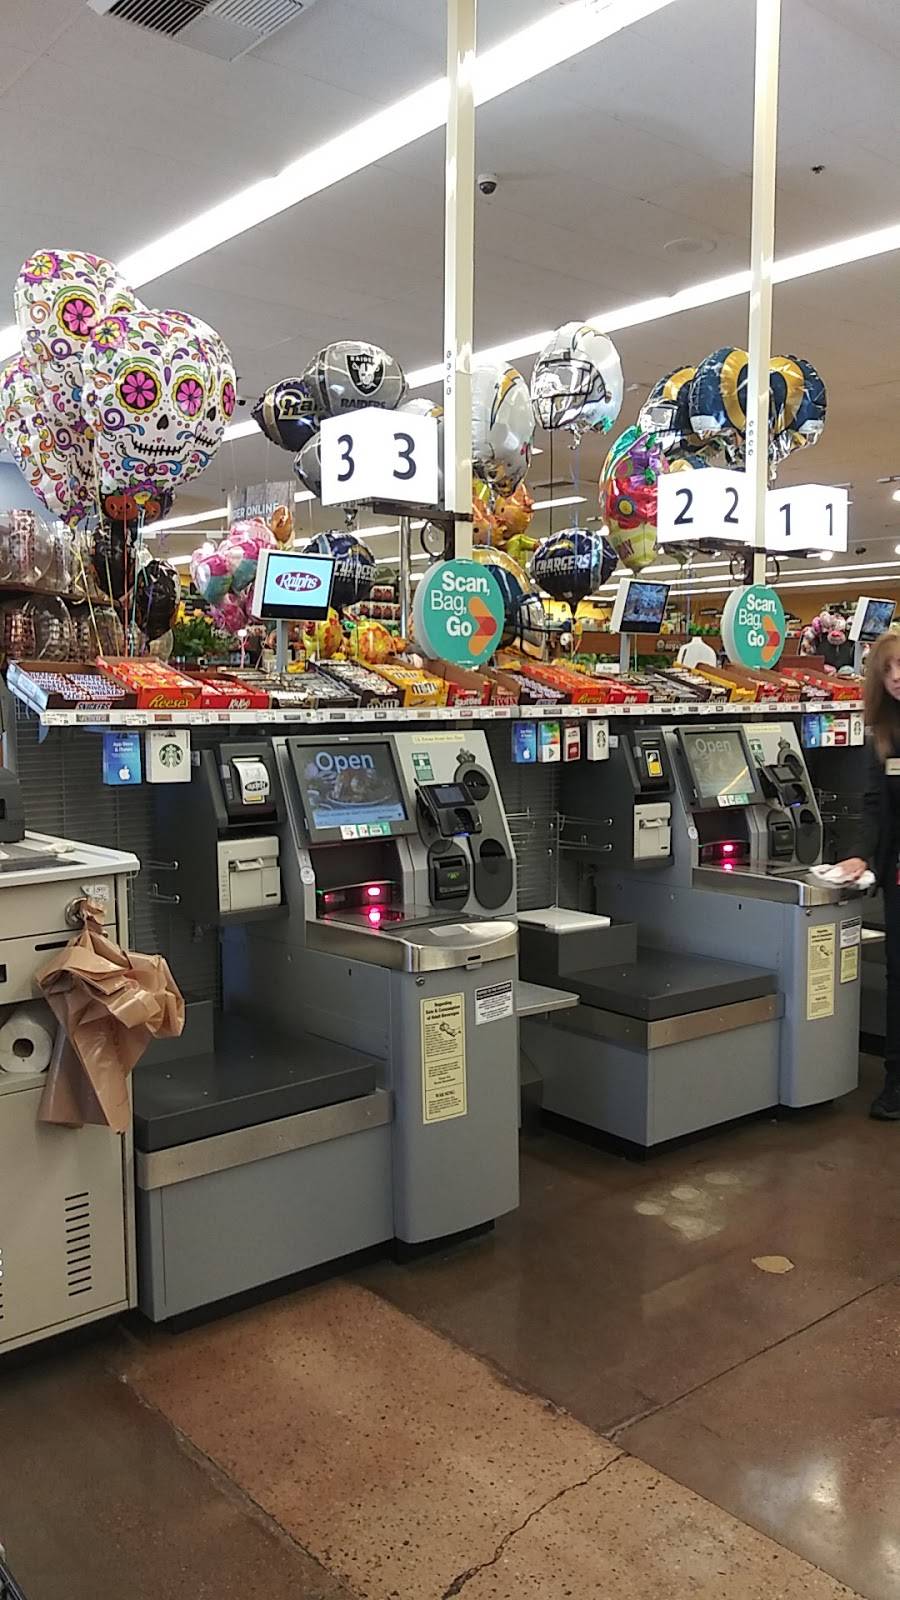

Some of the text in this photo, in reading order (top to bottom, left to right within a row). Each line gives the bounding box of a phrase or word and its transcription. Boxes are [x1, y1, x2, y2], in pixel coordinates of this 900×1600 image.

[337, 434, 355, 482] 3
[393, 432, 417, 480] 3
[674, 488, 694, 525] 2
[723, 487, 739, 524] 2
[779, 503, 791, 536] 1
[825, 503, 833, 536] 1
[535, 554, 591, 572] CHARGERS
[280, 573, 318, 592] Ralphs
[442, 571, 490, 596] Scan,
[431, 589, 467, 616] Bag,
[746, 594, 777, 614] Scan,
[446, 616, 472, 636] Go
[739, 609, 762, 630] Bag,
[747, 630, 764, 647] Go
[695, 738, 731, 757] Open
[315, 751, 374, 774] Open
